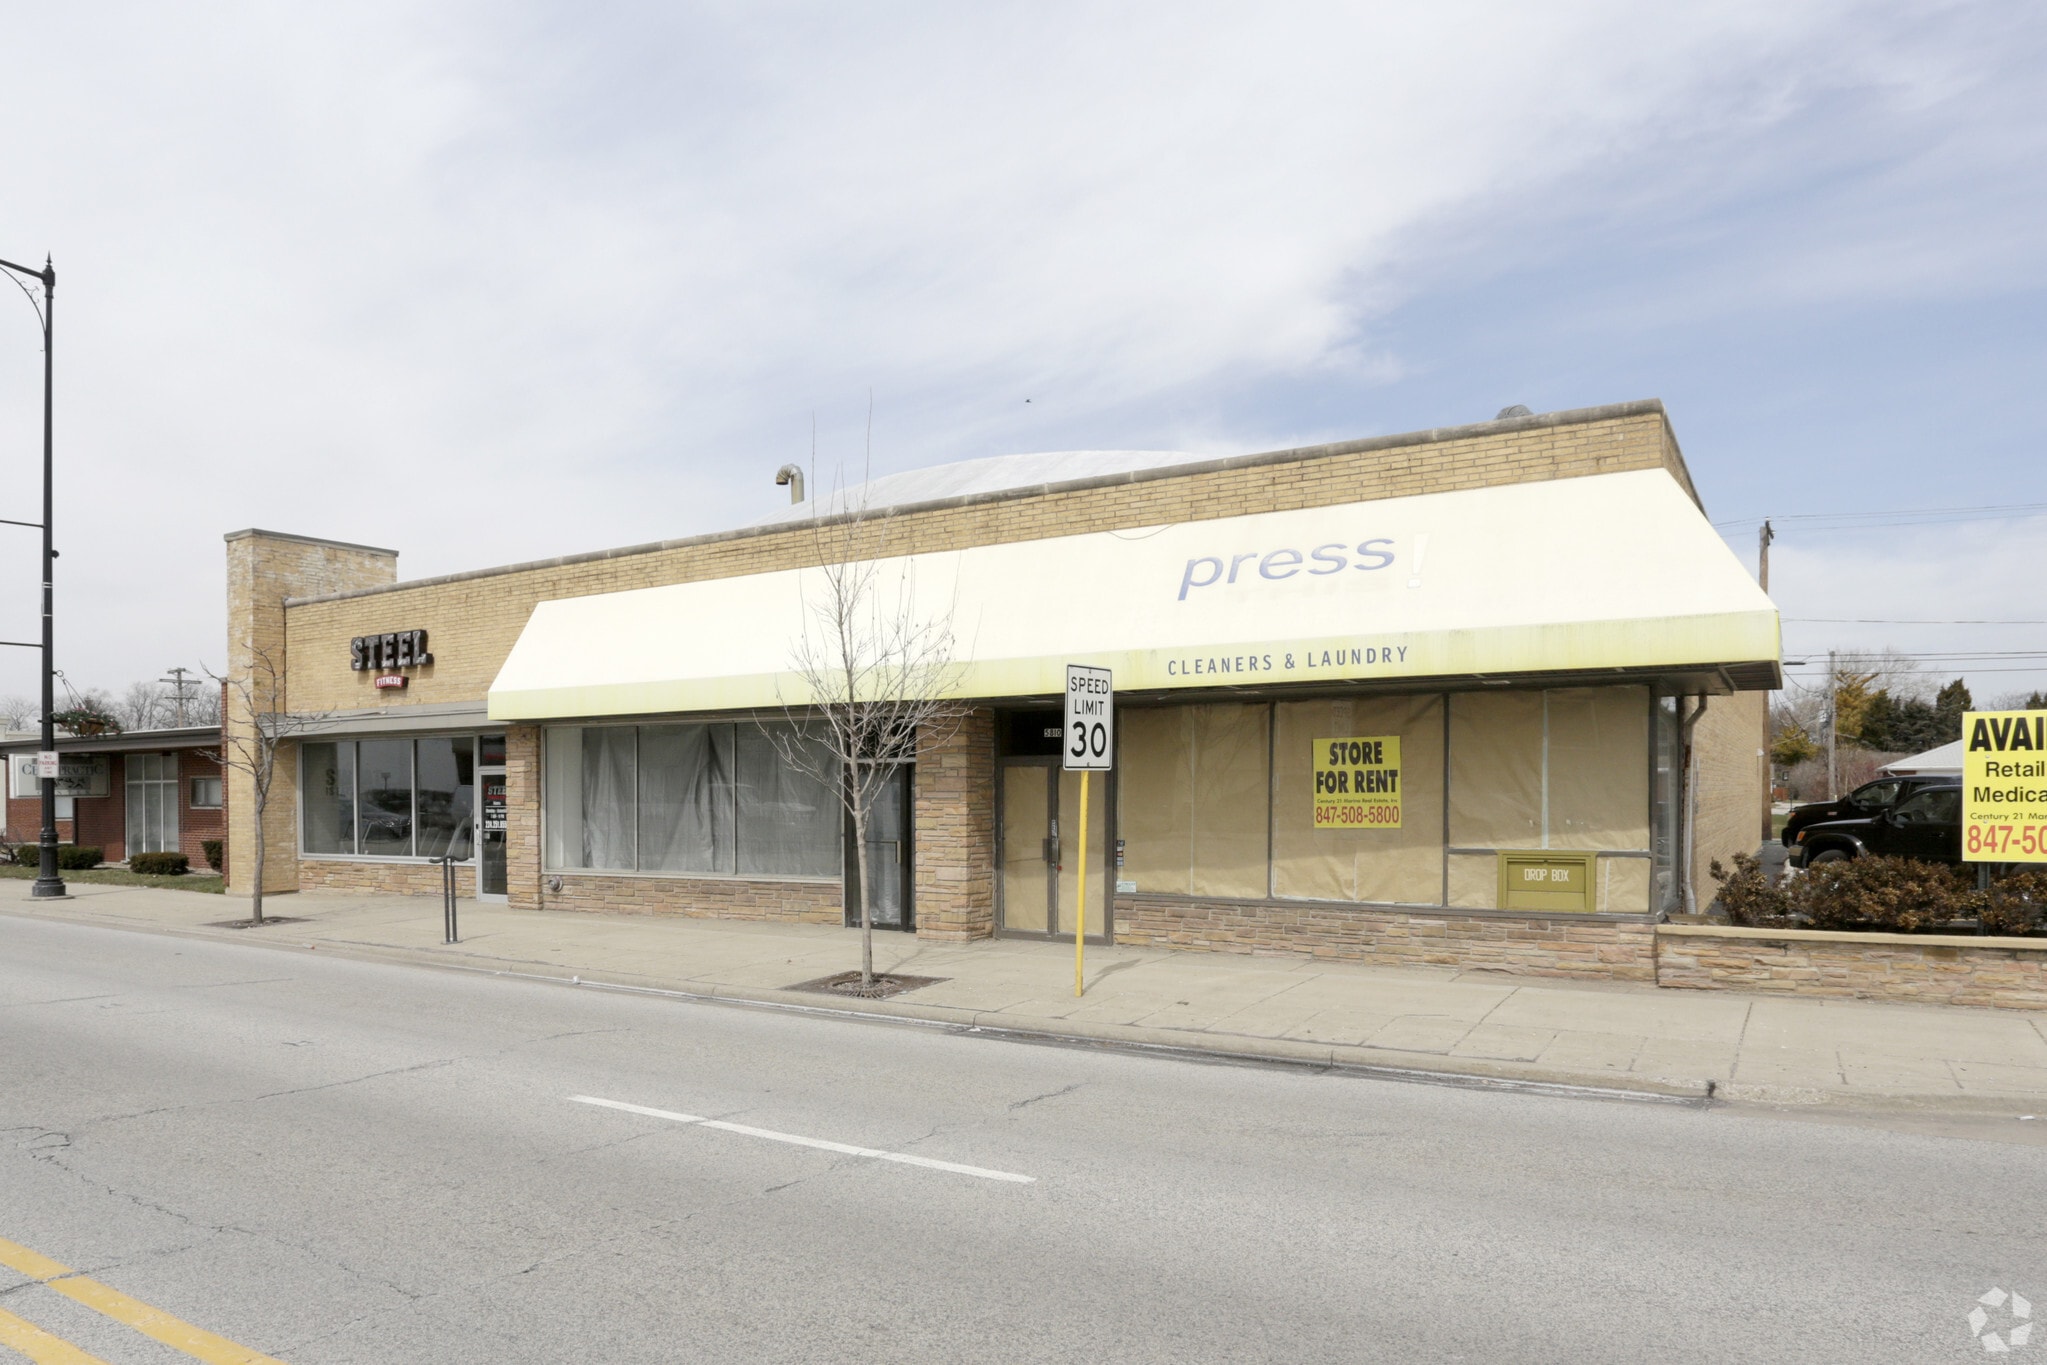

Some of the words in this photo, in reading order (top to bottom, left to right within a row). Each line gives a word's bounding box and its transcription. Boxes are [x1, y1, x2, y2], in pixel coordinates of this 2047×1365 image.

[351, 629, 434, 671] STEEL
[1168, 654, 1272, 676] CLEANERS
[1284, 653, 1295, 670] &
[1308, 646, 1408, 668] LAUNDRY
[376, 676, 402, 687] FITNESS
[1070, 676, 1109, 694] SPEED
[1074, 699, 1104, 716] LIMIT
[1070, 721, 1107, 758] 30
[1969, 717, 2047, 752] AVAI
[1329, 741, 1383, 765] STORE
[1985, 761, 2045, 777] Retail
[487, 785, 506, 795] STEE
[1316, 770, 1349, 794] FOR
[1354, 769, 1398, 793] RENT
[1974, 786, 2047, 803] Medica
[1316, 805, 1400, 824] 847-508-5800
[1970, 812, 2009, 822] Century
[2013, 812, 2024, 820] 21
[1524, 868, 1547, 881] DROP
[1551, 869, 1569, 882] BOX
